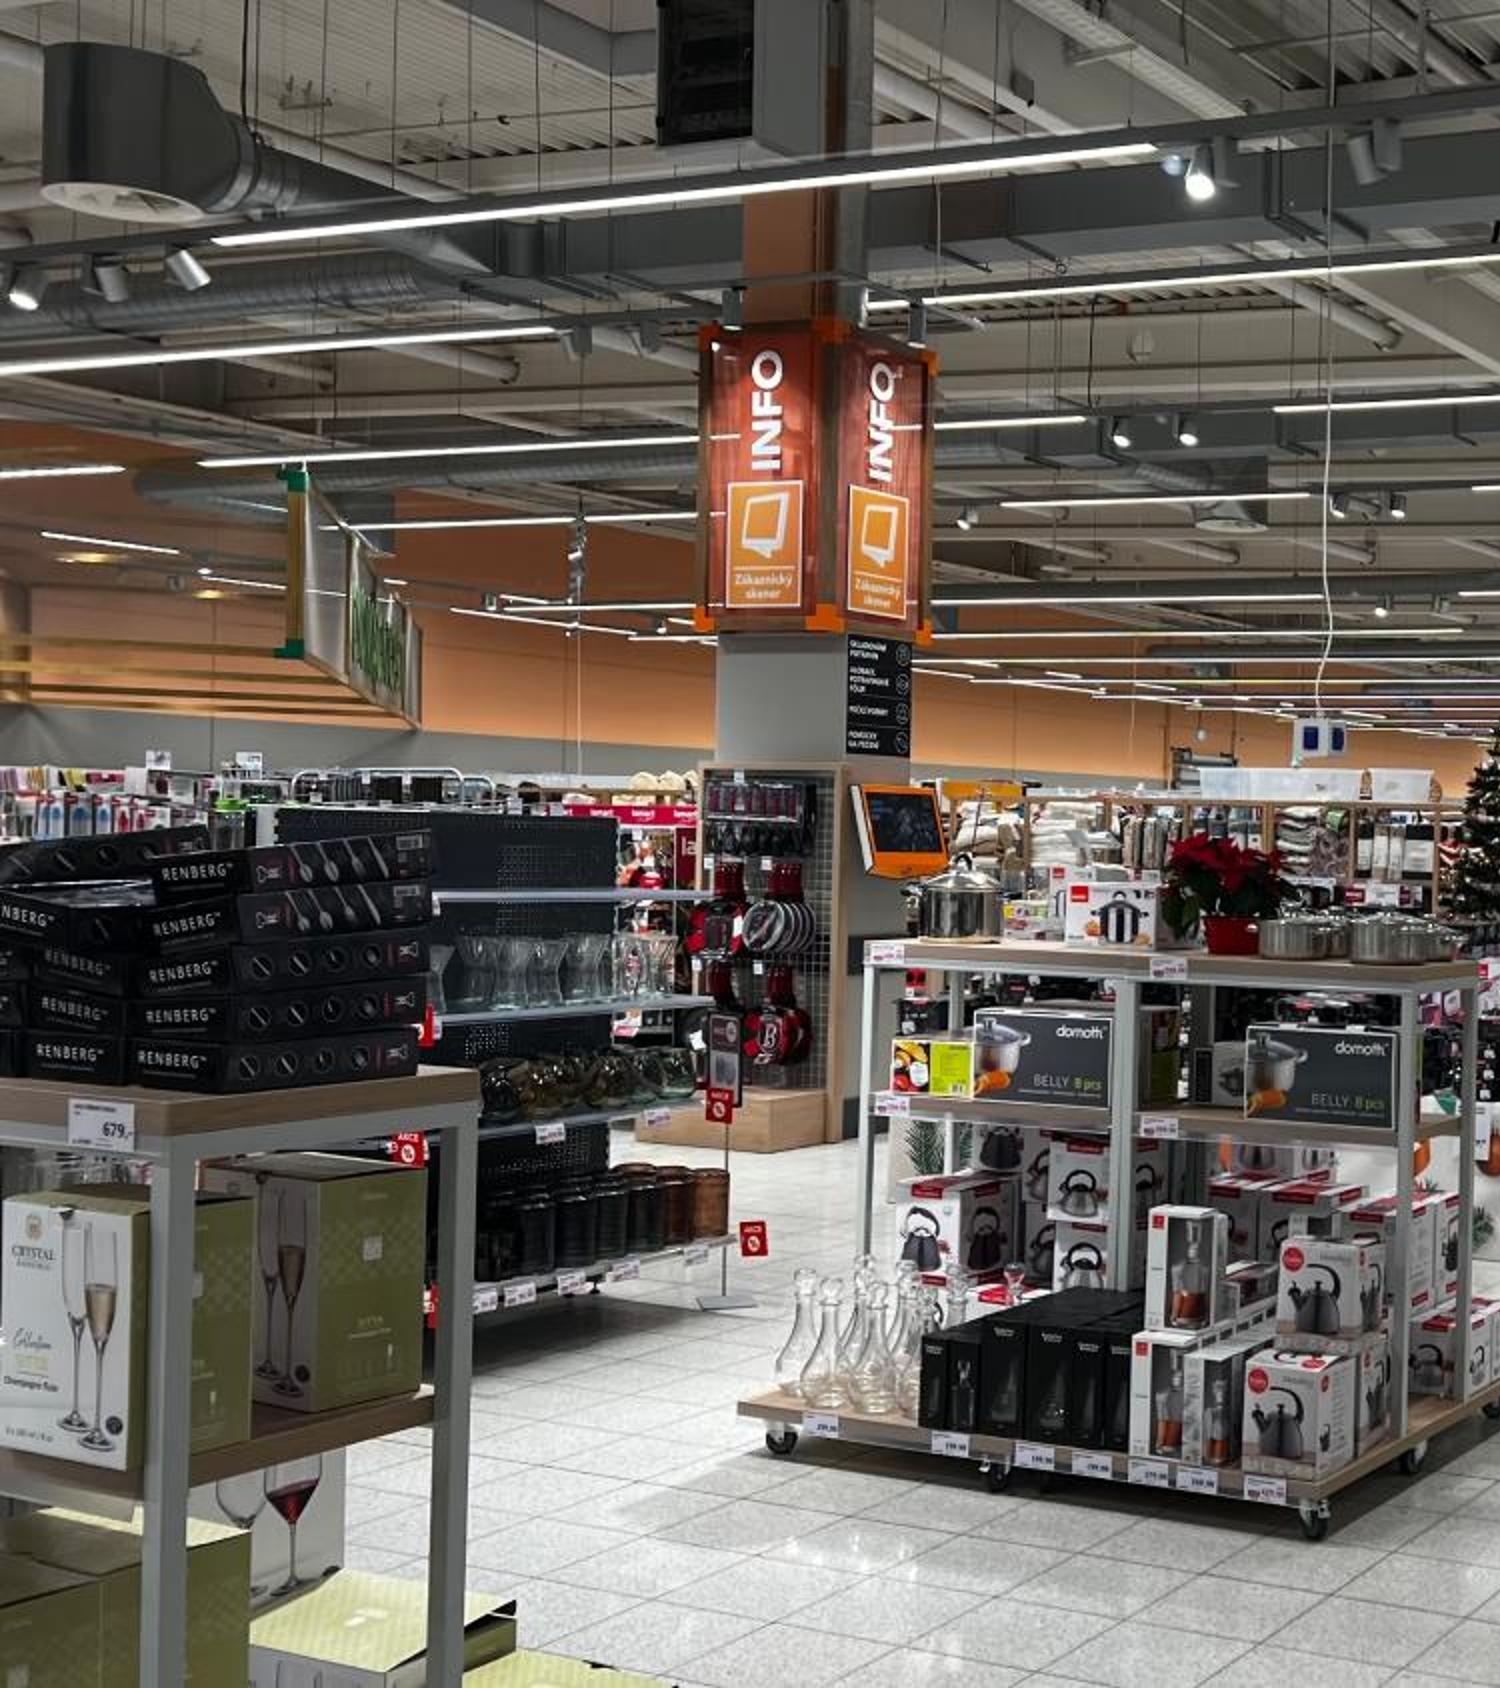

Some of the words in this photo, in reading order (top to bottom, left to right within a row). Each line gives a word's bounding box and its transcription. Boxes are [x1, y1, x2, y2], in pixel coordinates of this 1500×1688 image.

[751, 350, 784, 471] INFO
[868, 361, 895, 483] INFO
[734, 572, 793, 588] Zákaznický
[161, 862, 230, 881] RENBERG
[0, 904, 49, 927] NBERG
[152, 912, 218, 937] RENBERG
[149, 961, 214, 983] RENBERG
[41, 996, 103, 1022] RENBERG
[145, 1007, 211, 1023] RENBERG
[36, 1043, 99, 1062] RENBERG
[137, 1050, 202, 1069] RENBERG
[1033, 1072, 1070, 1089] BELLY
[1311, 1092, 1350, 1109] BELLY
